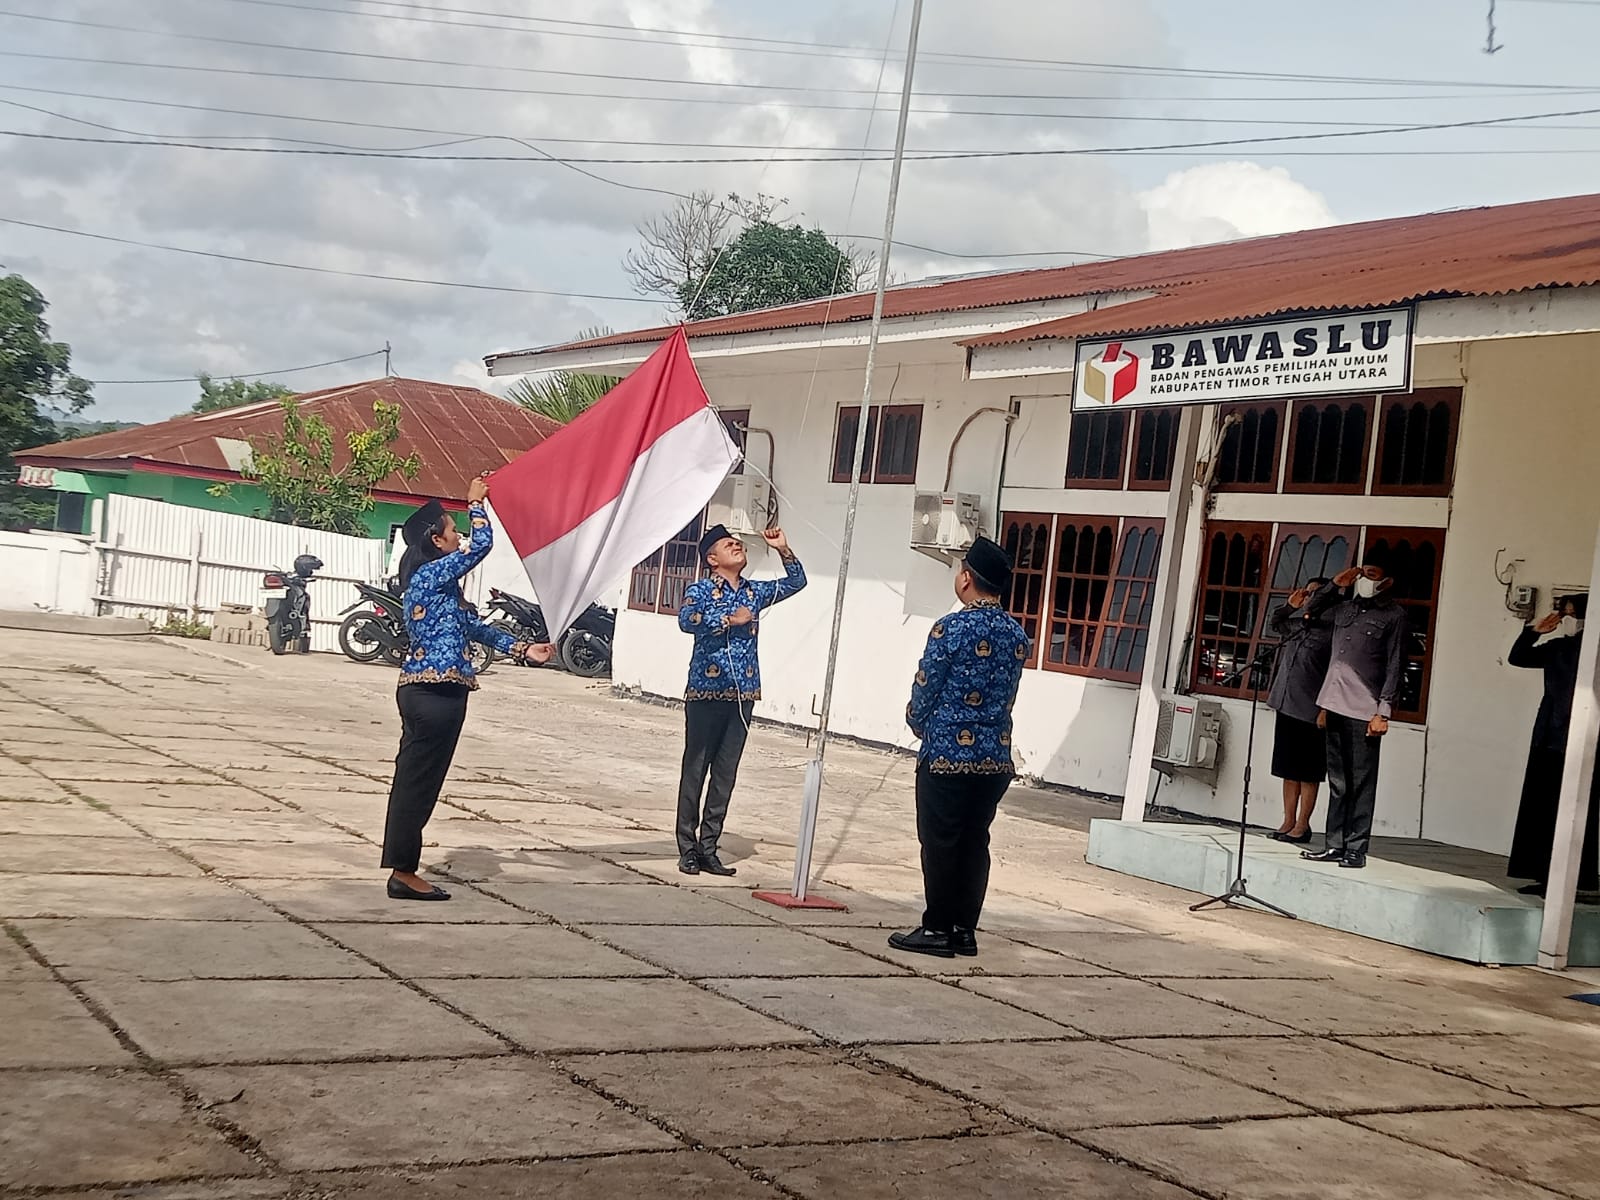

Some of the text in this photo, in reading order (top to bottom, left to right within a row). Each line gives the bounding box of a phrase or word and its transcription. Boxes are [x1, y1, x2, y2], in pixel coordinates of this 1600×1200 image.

[1151, 319, 1392, 370] BAWASLU
[1150, 367, 1387, 394] KABUPATEN TIMOR TENGAH UTARA
[1151, 354, 1388, 382] BADAN PENGAWAS PEMILIHAN UMUM
